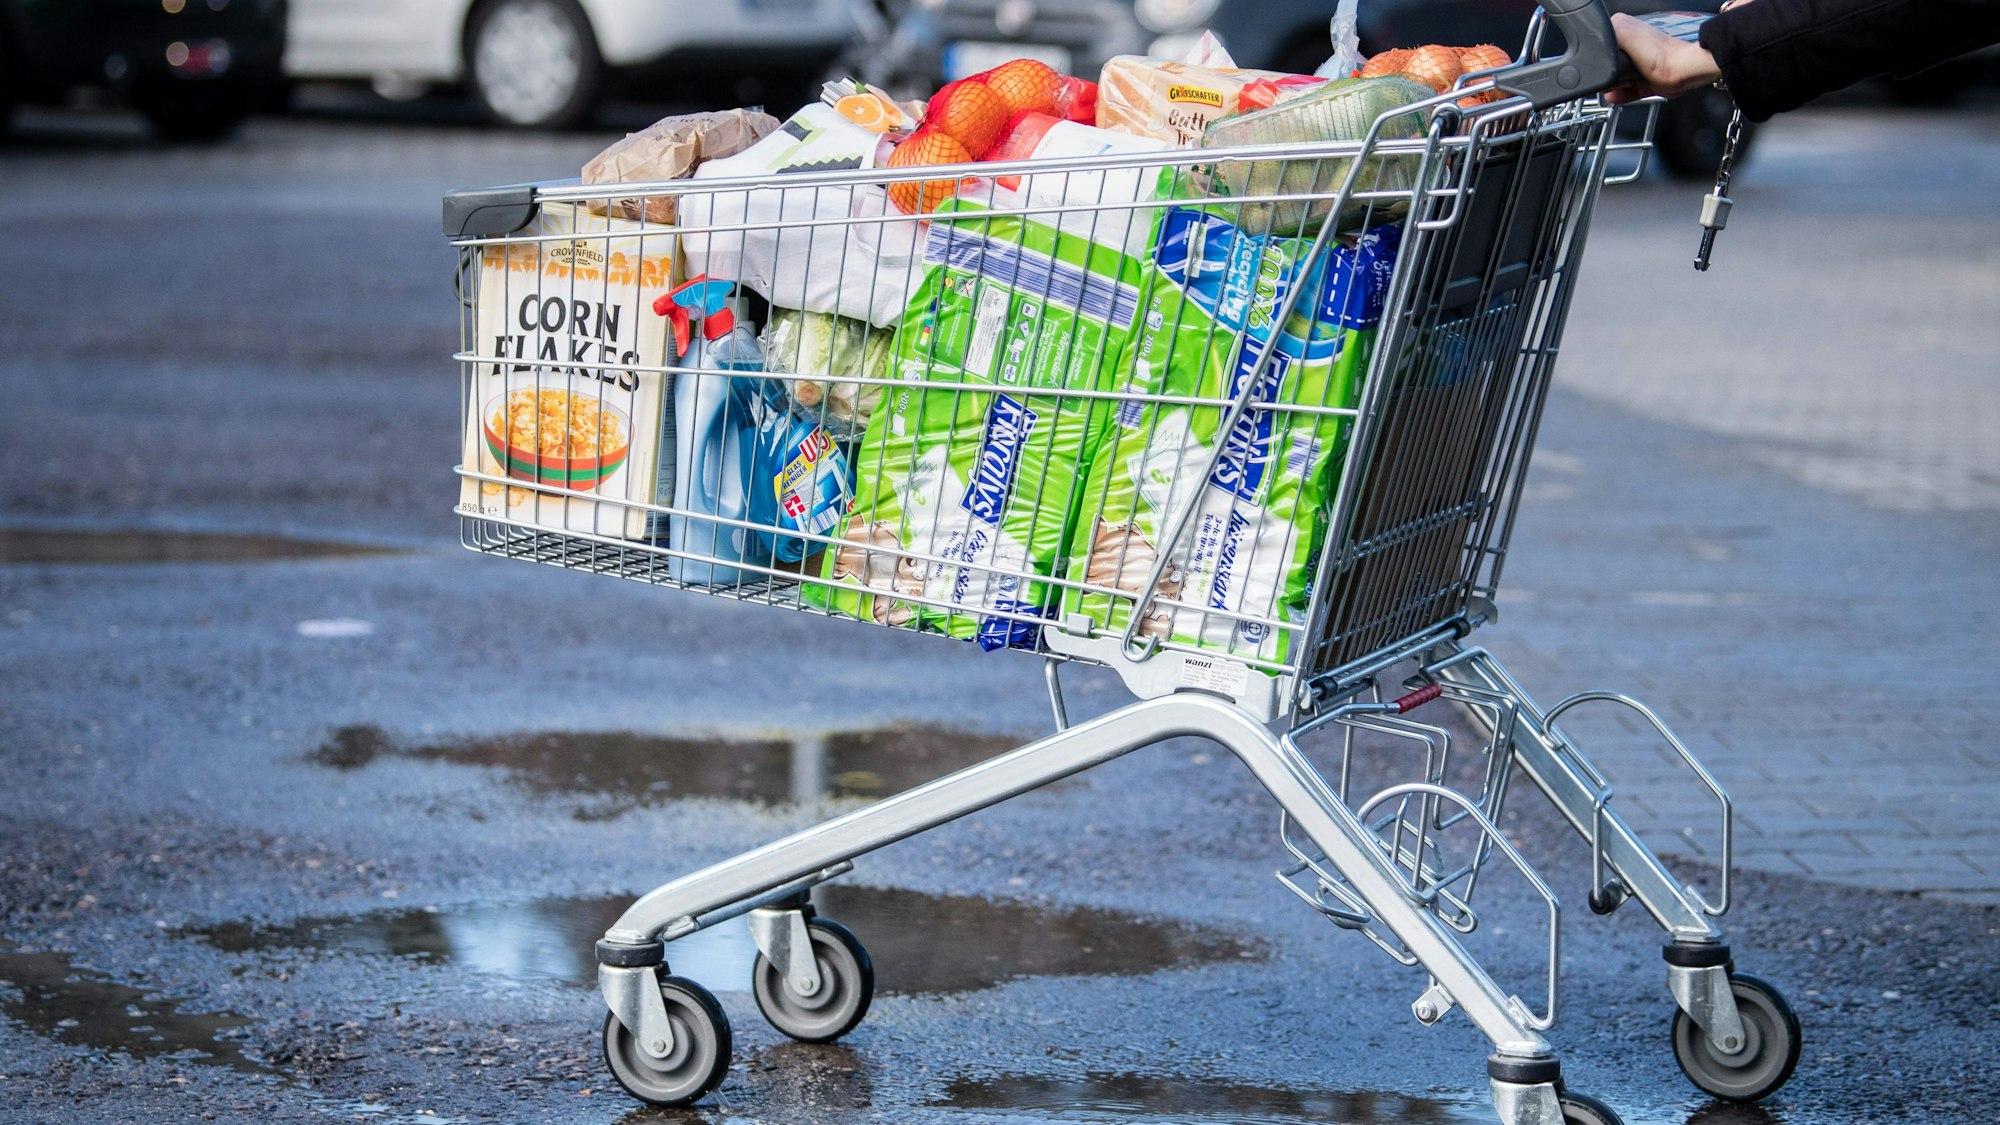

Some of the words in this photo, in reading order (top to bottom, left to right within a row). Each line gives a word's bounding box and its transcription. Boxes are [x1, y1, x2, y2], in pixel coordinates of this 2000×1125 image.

[1227, 238, 1257, 323] Recycling
[1249, 245, 1283, 329] 100%
[518, 293, 621, 342] CORN
[1152, 297, 1161, 308] 8x
[491, 335, 641, 393] FLAKES
[1048, 330, 1070, 387] bärenstark
[1142, 335, 1153, 359] 200x
[898, 392, 910, 415] 200x
[783, 465, 807, 489] REINIGER
[461, 503, 477, 512] 850
[1212, 509, 1249, 611] bärenstark
[1185, 658, 1212, 669] wanzl
